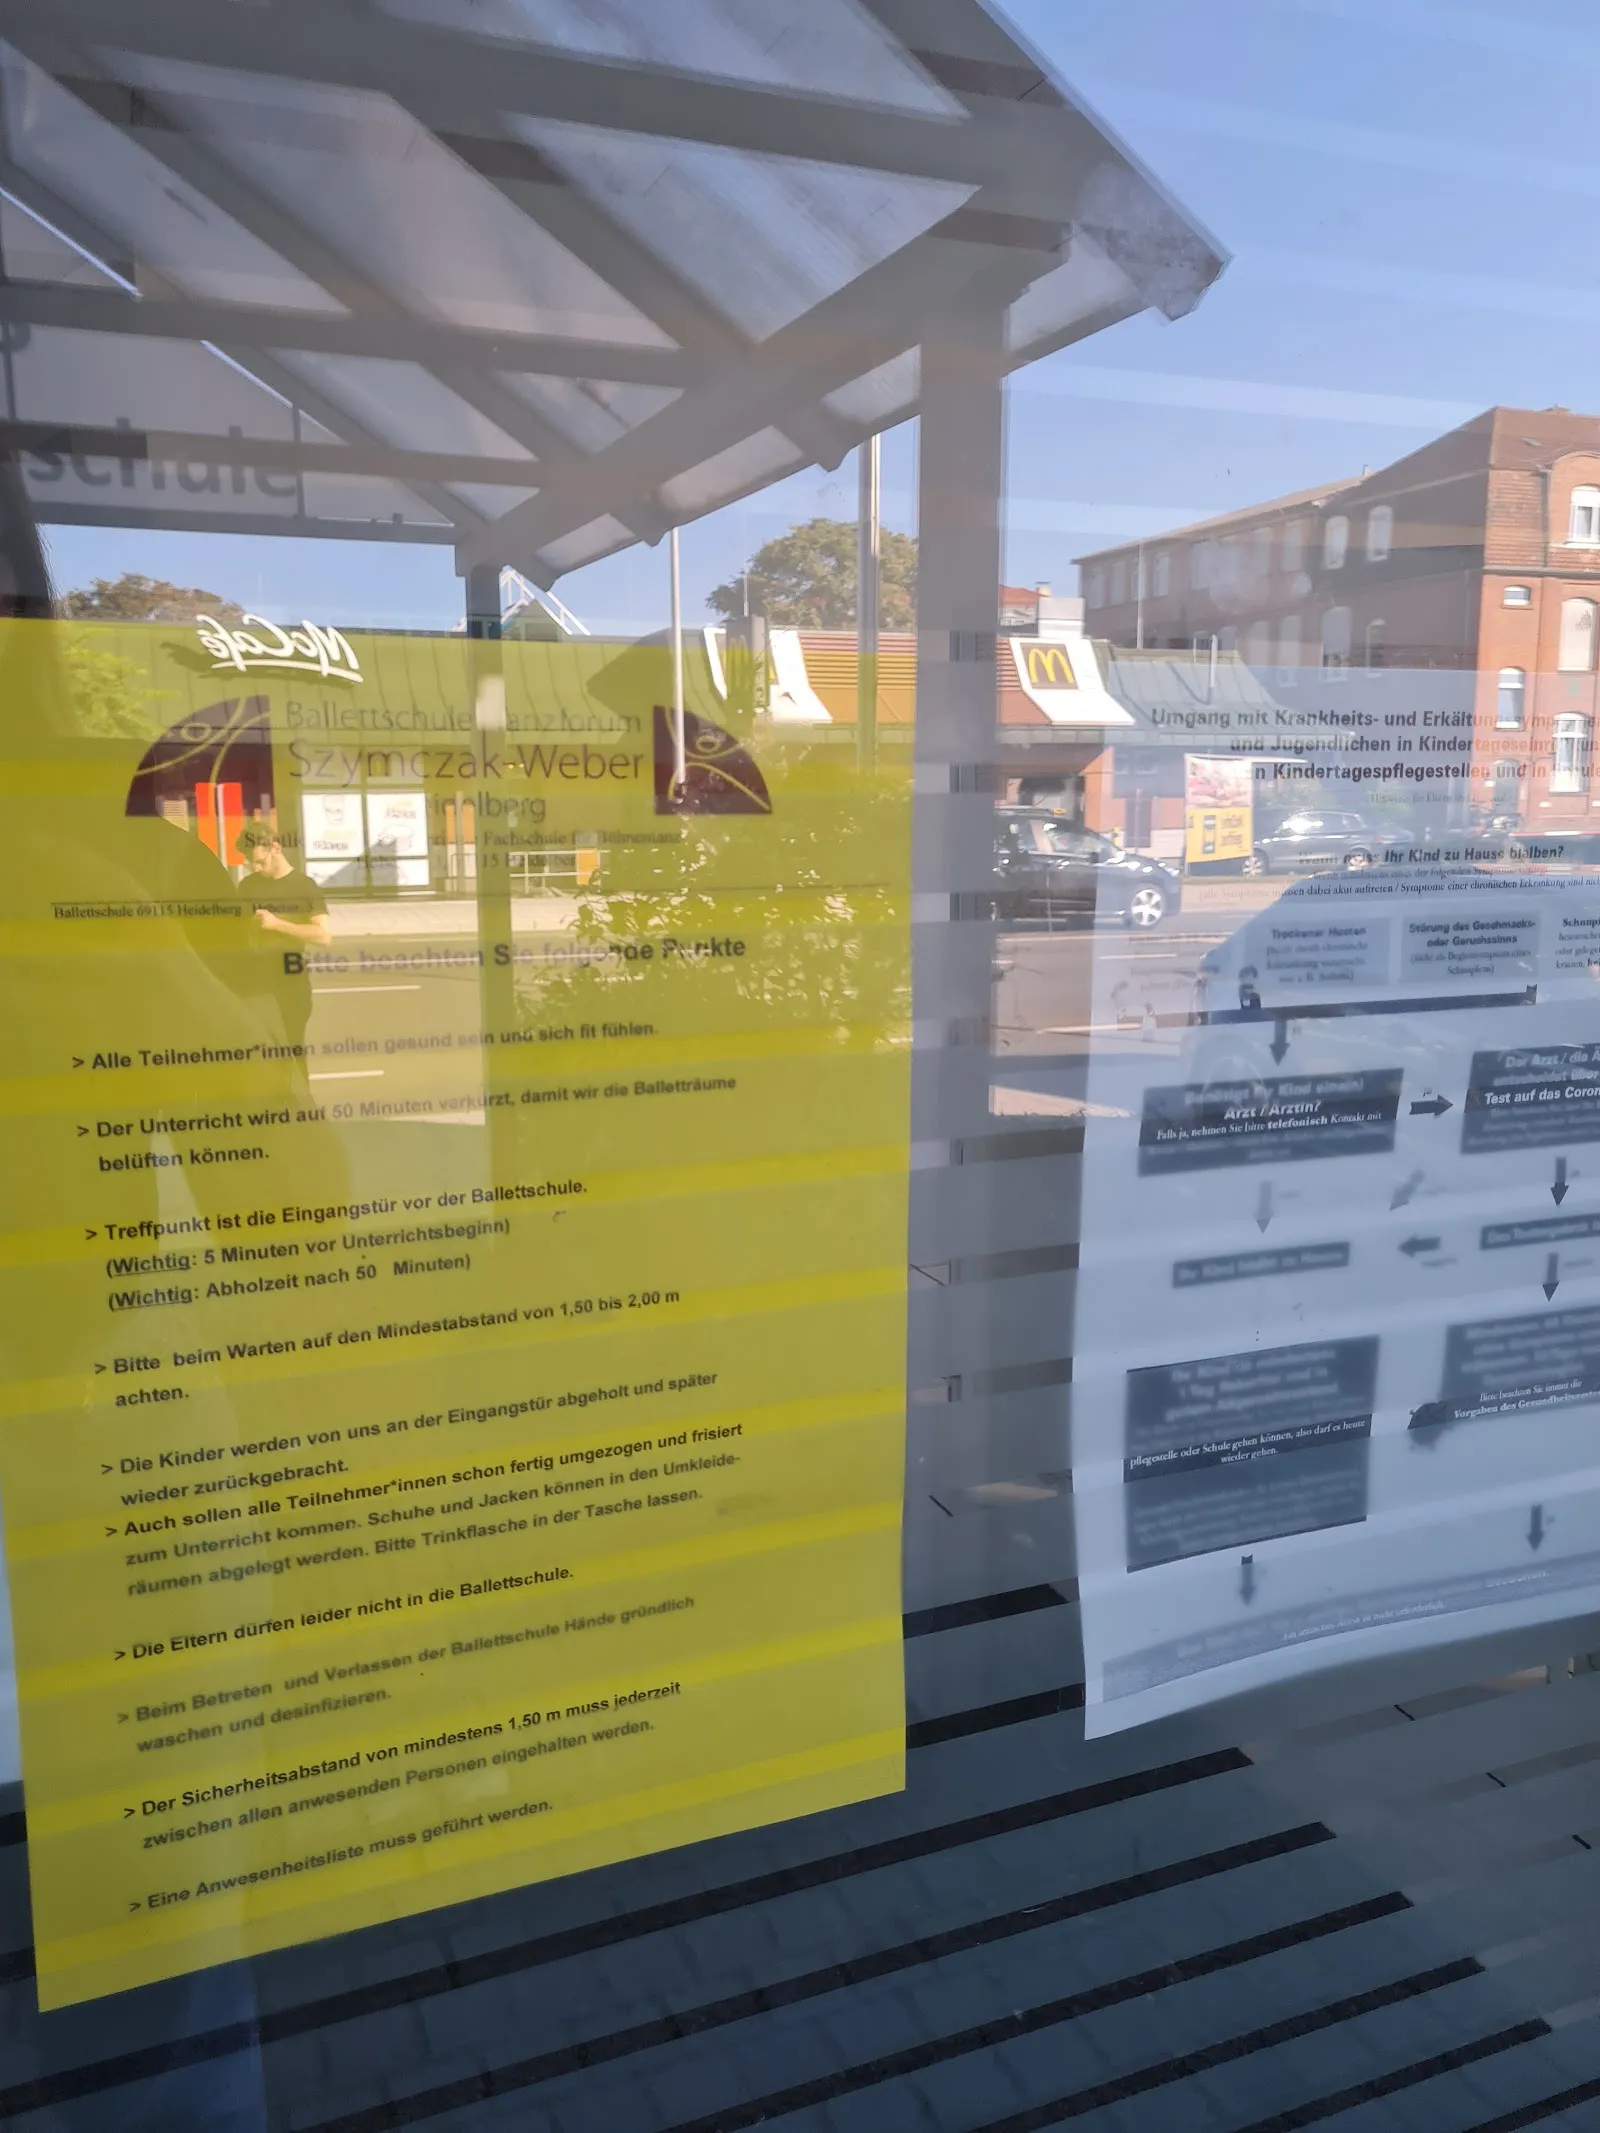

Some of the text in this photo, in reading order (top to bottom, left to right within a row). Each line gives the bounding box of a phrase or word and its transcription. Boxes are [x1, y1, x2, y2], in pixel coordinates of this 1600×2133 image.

[286, 701, 641, 733] Ballettschule anzforum
[1152, 708, 1417, 728] Umgang mit Krankheits- und
[1230, 735, 1413, 755] und Jugendlichen in
[289, 735, 644, 788] Szymczak-Weber
[1273, 763, 1490, 783] Kindertagespflegestellen
[1532, 763, 1546, 778] in
[1385, 850, 1403, 863] Ihr
[1408, 848, 1440, 862] Kind
[1444, 851, 1460, 861] zu
[1464, 847, 1504, 861] Hause
[1307, 884, 1331, 896] dabei
[54, 903, 242, 919] Ballettschule 69115 Heidelberg
[284, 936, 746, 975] Bitte beachten Sie folgende Punkte
[92, 1052, 131, 1070] Alle
[321, 1037, 379, 1055] sollen
[385, 1032, 452, 1055] gesund
[457, 1031, 494, 1047] sein
[500, 1028, 533, 1044] und
[538, 1026, 574, 1042] sich
[580, 1023, 597, 1038] fit
[602, 1021, 658, 1037] fühlen.
[97, 1076, 736, 1138] Der Unterricht wird auf 50 Minuten verkürzt, damit wir die Balletträume
[1484, 1092, 1511, 1105] Test
[1514, 1088, 1537, 1103] auf
[1539, 1088, 1561, 1101] das
[1191, 1124, 1227, 1138] nehmen
[1229, 1122, 1243, 1133] Sie
[1244, 1121, 1265, 1132] bitte
[1267, 1115, 1328, 1130] telefonisch
[1224, 1106, 1257, 1120] Arzt
[99, 1145, 269, 1173] belüften können.
[104, 1179, 587, 1241] Treffpunkt ist die Eingangstür vor der Ballettschule.
[106, 1218, 510, 1278] (Wichtig: 5 Minuten vor Unterrichtsbeginn)
[113, 1290, 680, 1374] Bitte beim Warten auf den Mindestabstand von 1,50 bis 2,00 m
[116, 1385, 189, 1408] achten.
[1454, 1401, 1517, 1420] Vorgaben des
[1130, 1450, 1179, 1469] pflegestelle
[1180, 1446, 1201, 1458] oder
[1202, 1440, 1231, 1454] Schule
[1231, 1437, 1258, 1451] gehen
[1259, 1430, 1293, 1445] können,
[1295, 1426, 1312, 1438] also
[1313, 1422, 1332, 1435] darf
[1343, 1418, 1366, 1431] heute
[1220, 1446, 1278, 1464] wieder gehen.
[124, 1515, 176, 1536] Auch
[183, 1506, 242, 1526] sollen
[248, 1500, 281, 1516] alle
[452, 1463, 505, 1484] schon
[510, 1455, 554, 1474] fertig
[559, 1439, 653, 1466] umgezogen
[658, 1432, 688, 1449] und
[692, 1423, 743, 1443] frisiert
[133, 1567, 574, 1659] Die Eltern dürfen leider nicht in die Ballettschule.
[142, 1680, 681, 1816] Der Sicherheitsabstand von mindestens 1,50 m muss jederzeit
[148, 1799, 553, 1909] Eine Anwesenheitsliste muss geführt werden.
